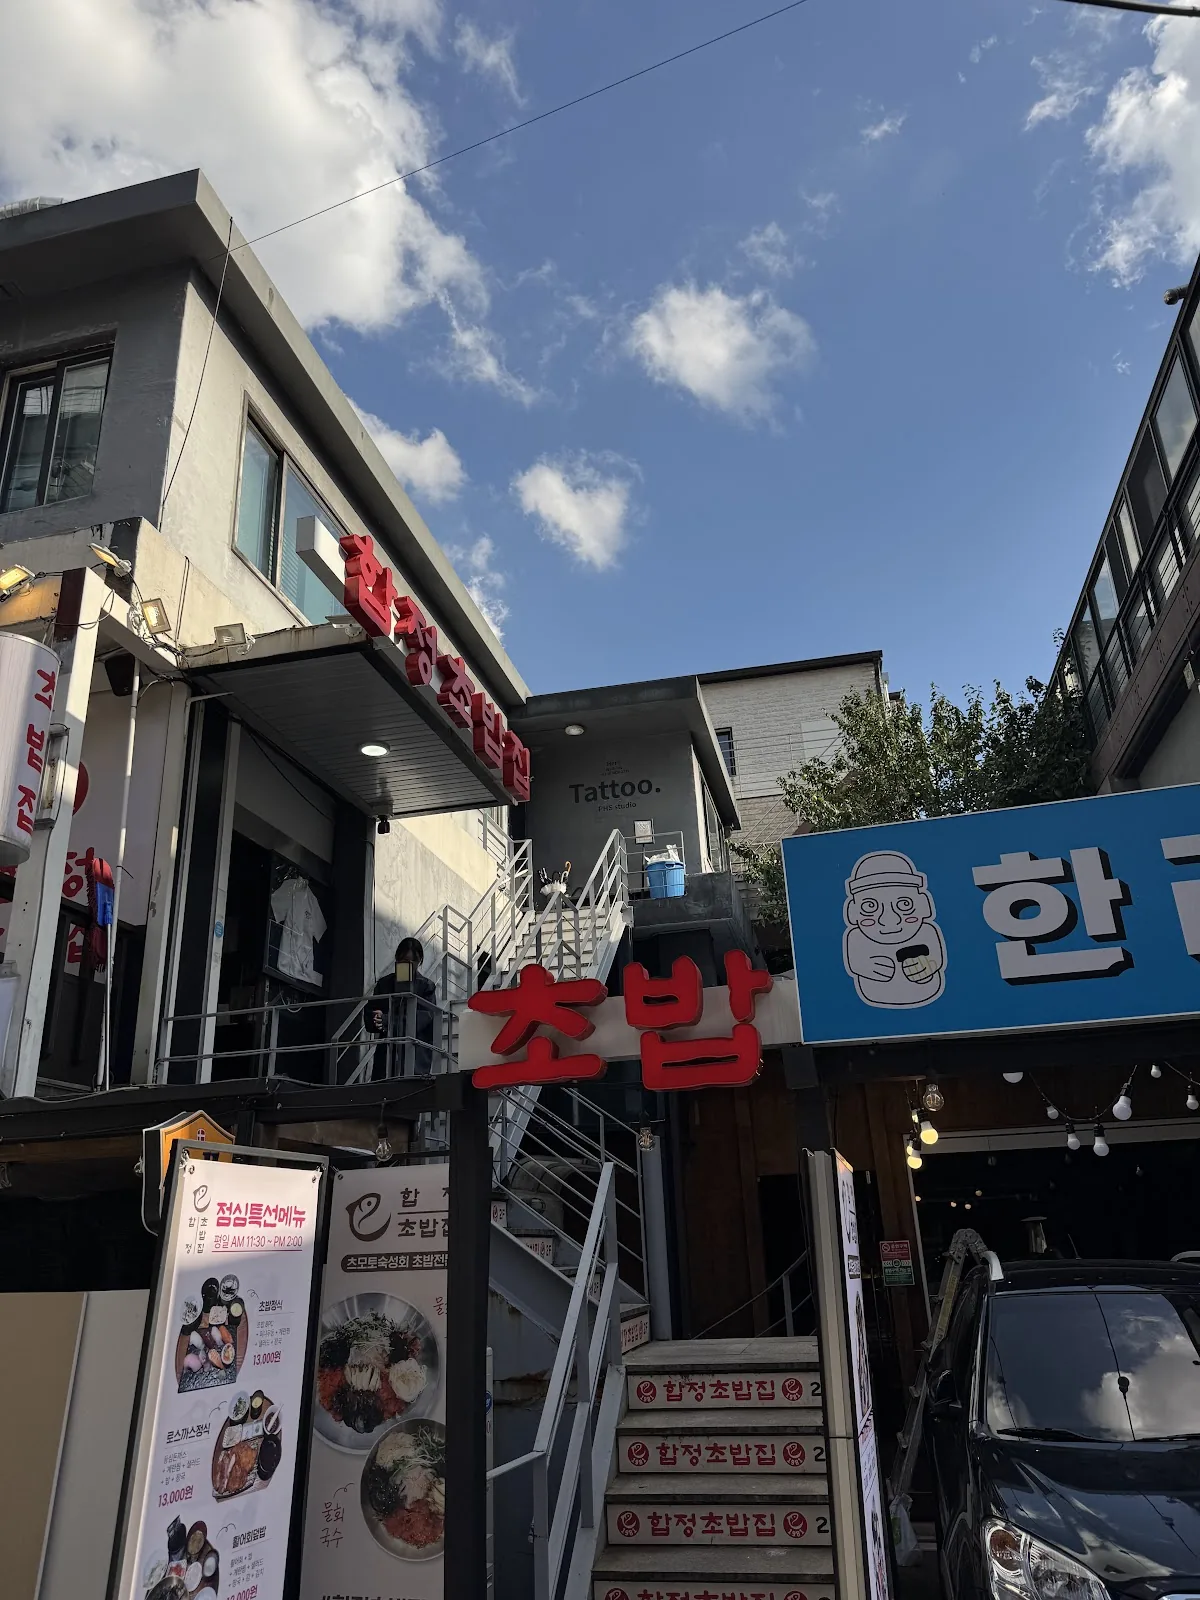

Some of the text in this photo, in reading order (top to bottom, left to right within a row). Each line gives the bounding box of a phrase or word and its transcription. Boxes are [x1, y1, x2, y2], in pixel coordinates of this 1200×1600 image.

[339, 533, 530, 802] 합정초밥집
[568, 779, 661, 804] Tattoo.
[614, 801, 637, 809] studio
[467, 943, 775, 1092] 초밥
[216, 1202, 306, 1229] 점심특선메뉴
[214, 1235, 230, 1249] 평일
[230, 1236, 245, 1247] AM
[246, 1235, 266, 1248] 11:30
[273, 1236, 286, 1247] PM
[286, 1235, 303, 1247] 2:00
[346, 1255, 410, 1270] 츠모토숙성회
[258, 1300, 283, 1312] 초밥정식
[253, 1351, 282, 1366] 13,000원
[663, 1380, 775, 1402] 합정초밥집
[166, 1423, 211, 1444] 로스까스정식
[656, 1442, 776, 1466] 합정초밥집
[158, 1485, 193, 1508] 13,000원
[322, 1501, 345, 1522] 물회
[647, 1511, 776, 1538] 합정초밥집
[232, 1526, 267, 1549] 활어회덮밥
[320, 1527, 344, 1548] 국수
